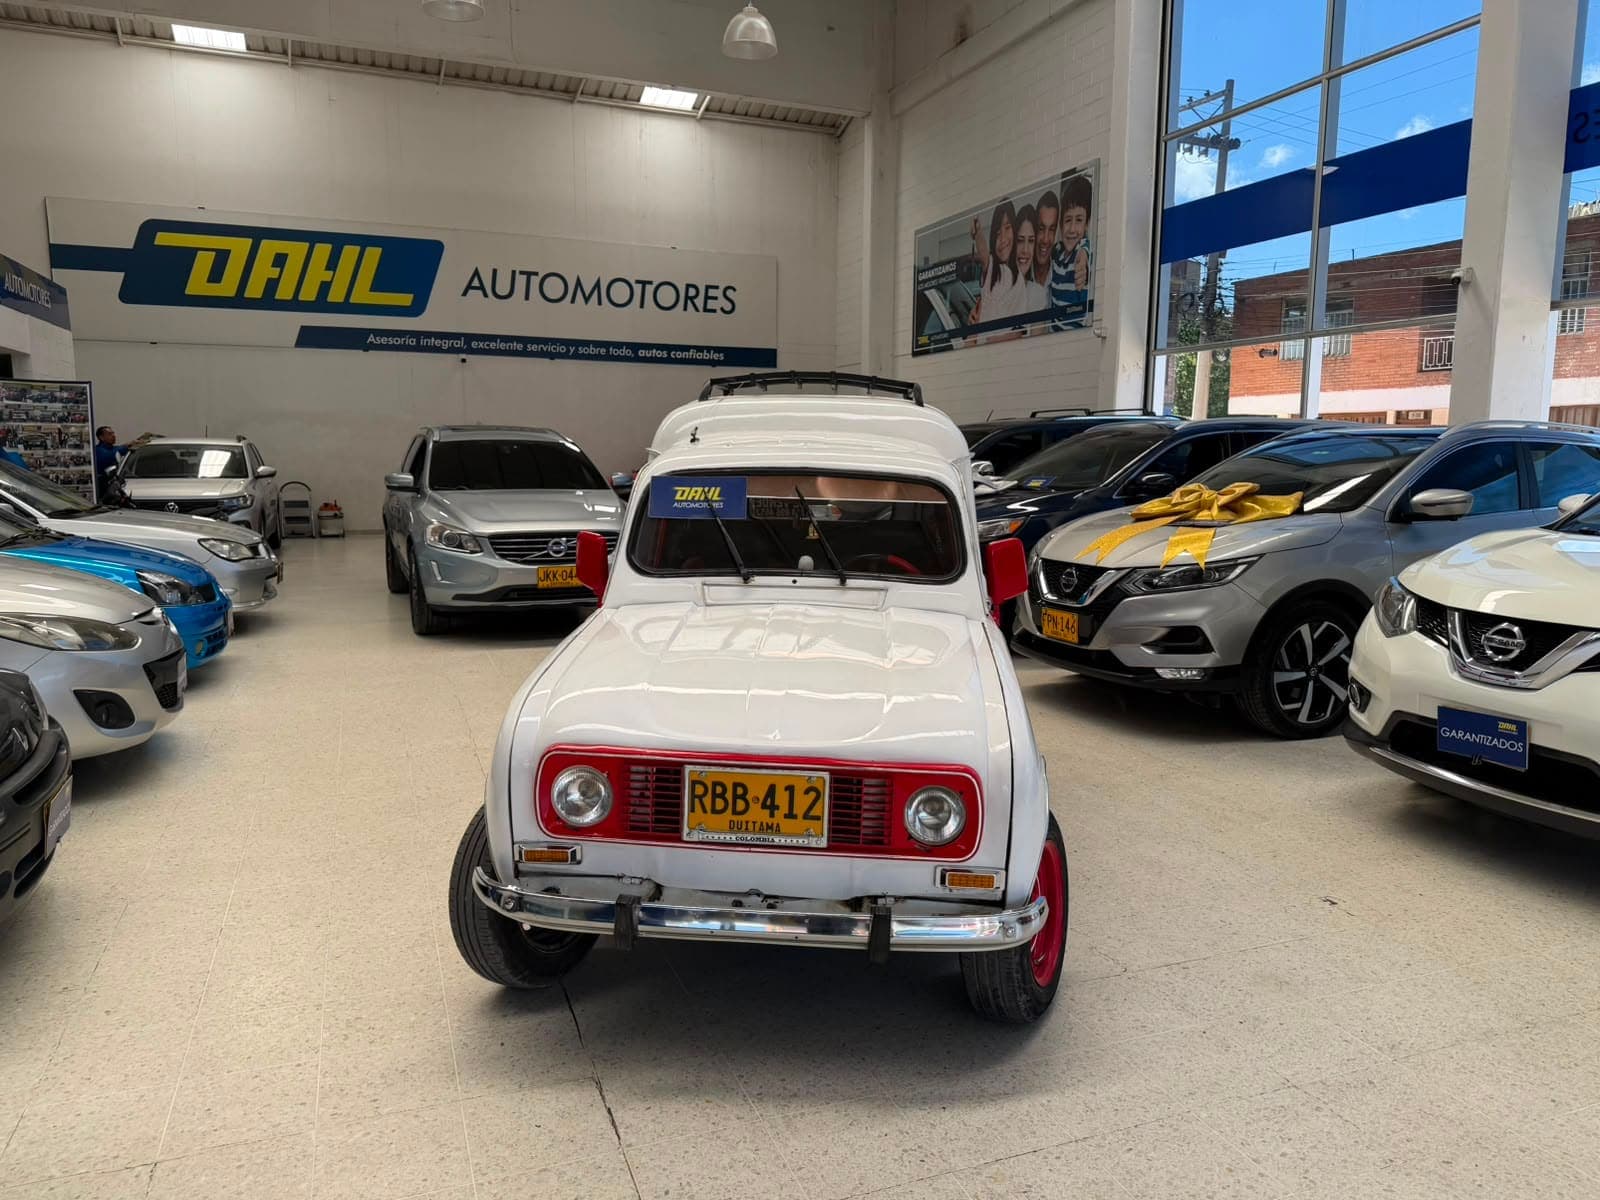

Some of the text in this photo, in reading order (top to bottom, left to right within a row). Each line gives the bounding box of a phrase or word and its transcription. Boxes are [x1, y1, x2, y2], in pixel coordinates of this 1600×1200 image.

[154, 231, 737, 315] DAHL AUTOMOTORES
[4, 271, 52, 309] AUTOMOTORES
[366, 333, 725, 361] Asesoría integral, excelente servicio y sobre todo, autos confiables
[672, 486, 726, 501] DAHL
[539, 569, 577, 583] JKK-04
[1440, 727, 1523, 753] GARANTIZADOS
[728, 819, 781, 833] DUITAMA
[735, 835, 776, 844] COLOMBIA
